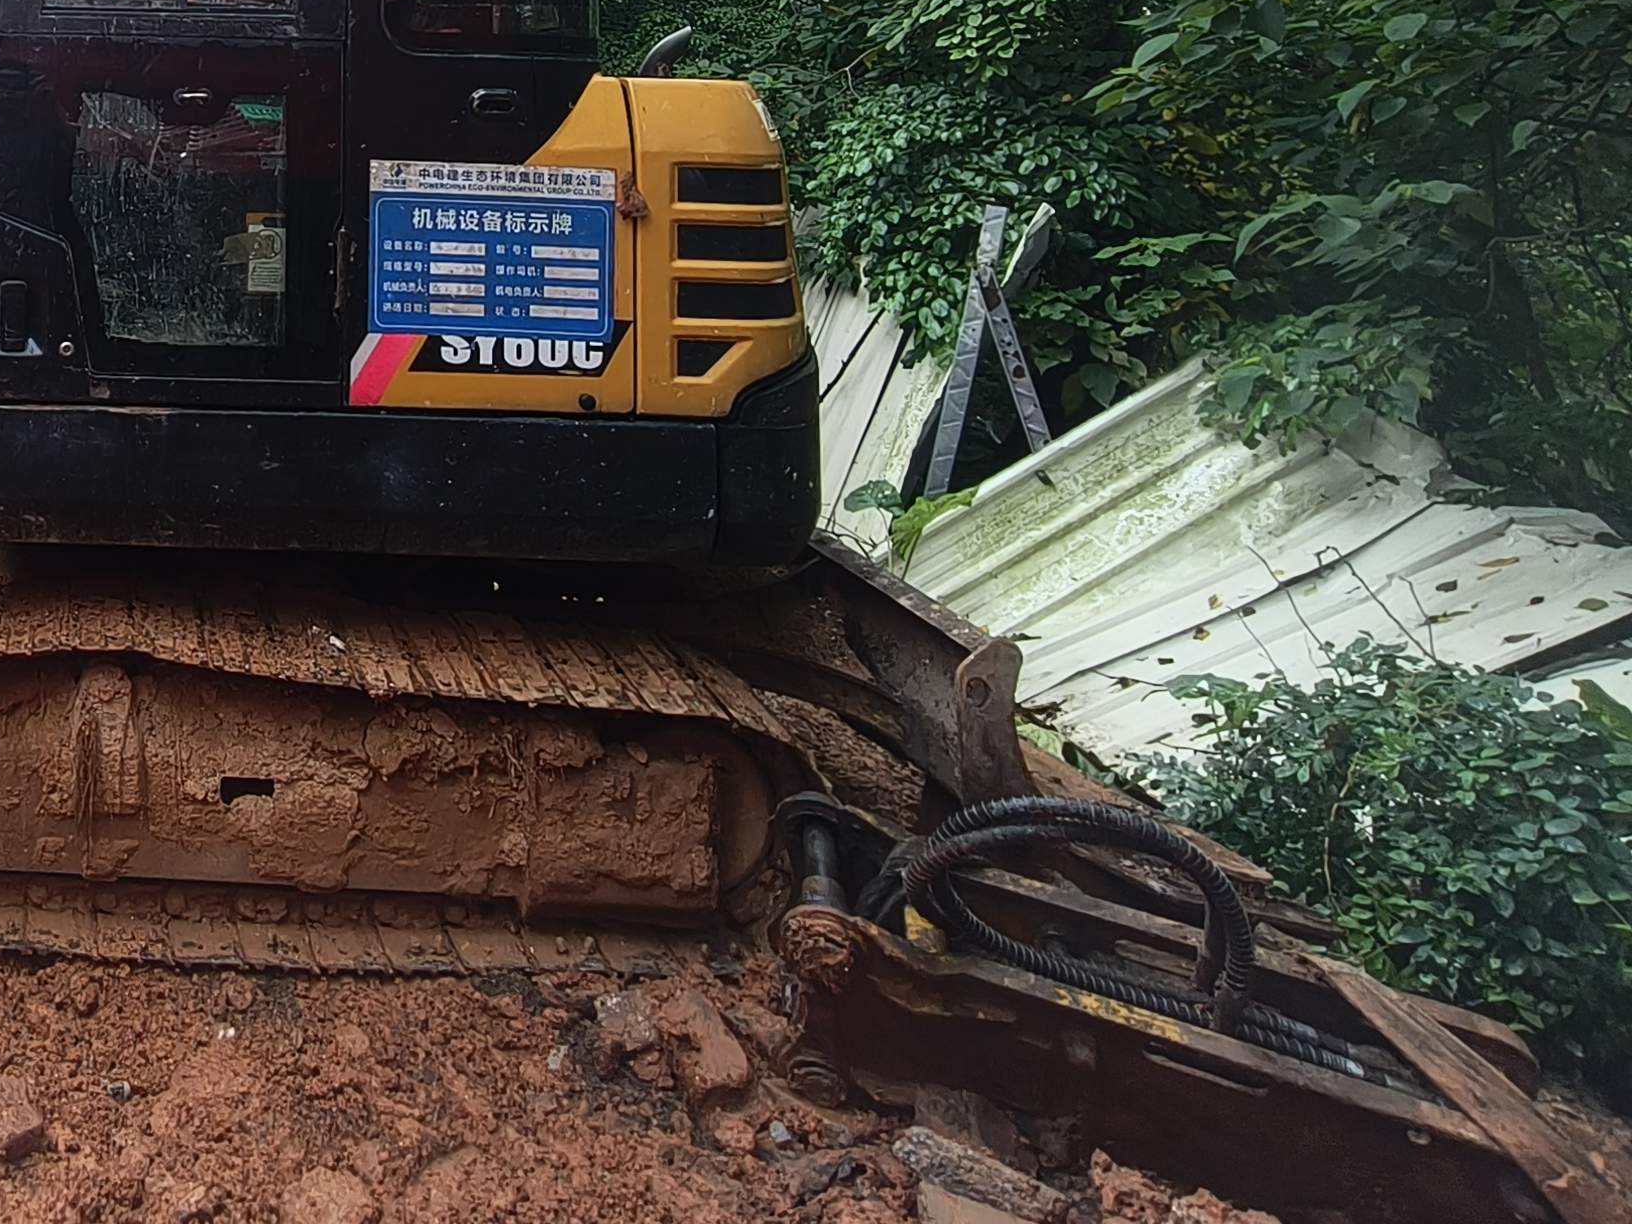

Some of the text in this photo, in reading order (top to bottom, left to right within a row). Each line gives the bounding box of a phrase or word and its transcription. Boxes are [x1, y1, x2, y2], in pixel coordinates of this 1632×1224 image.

[419, 167, 602, 187] 中电建生态环境集团有限公司
[419, 182, 467, 191] POWERCHINA
[468, 183, 545, 194] ECO-ENVIRONMENTAL
[547, 186, 572, 194] GROUP
[412, 206, 573, 236] 机械设备标示牌
